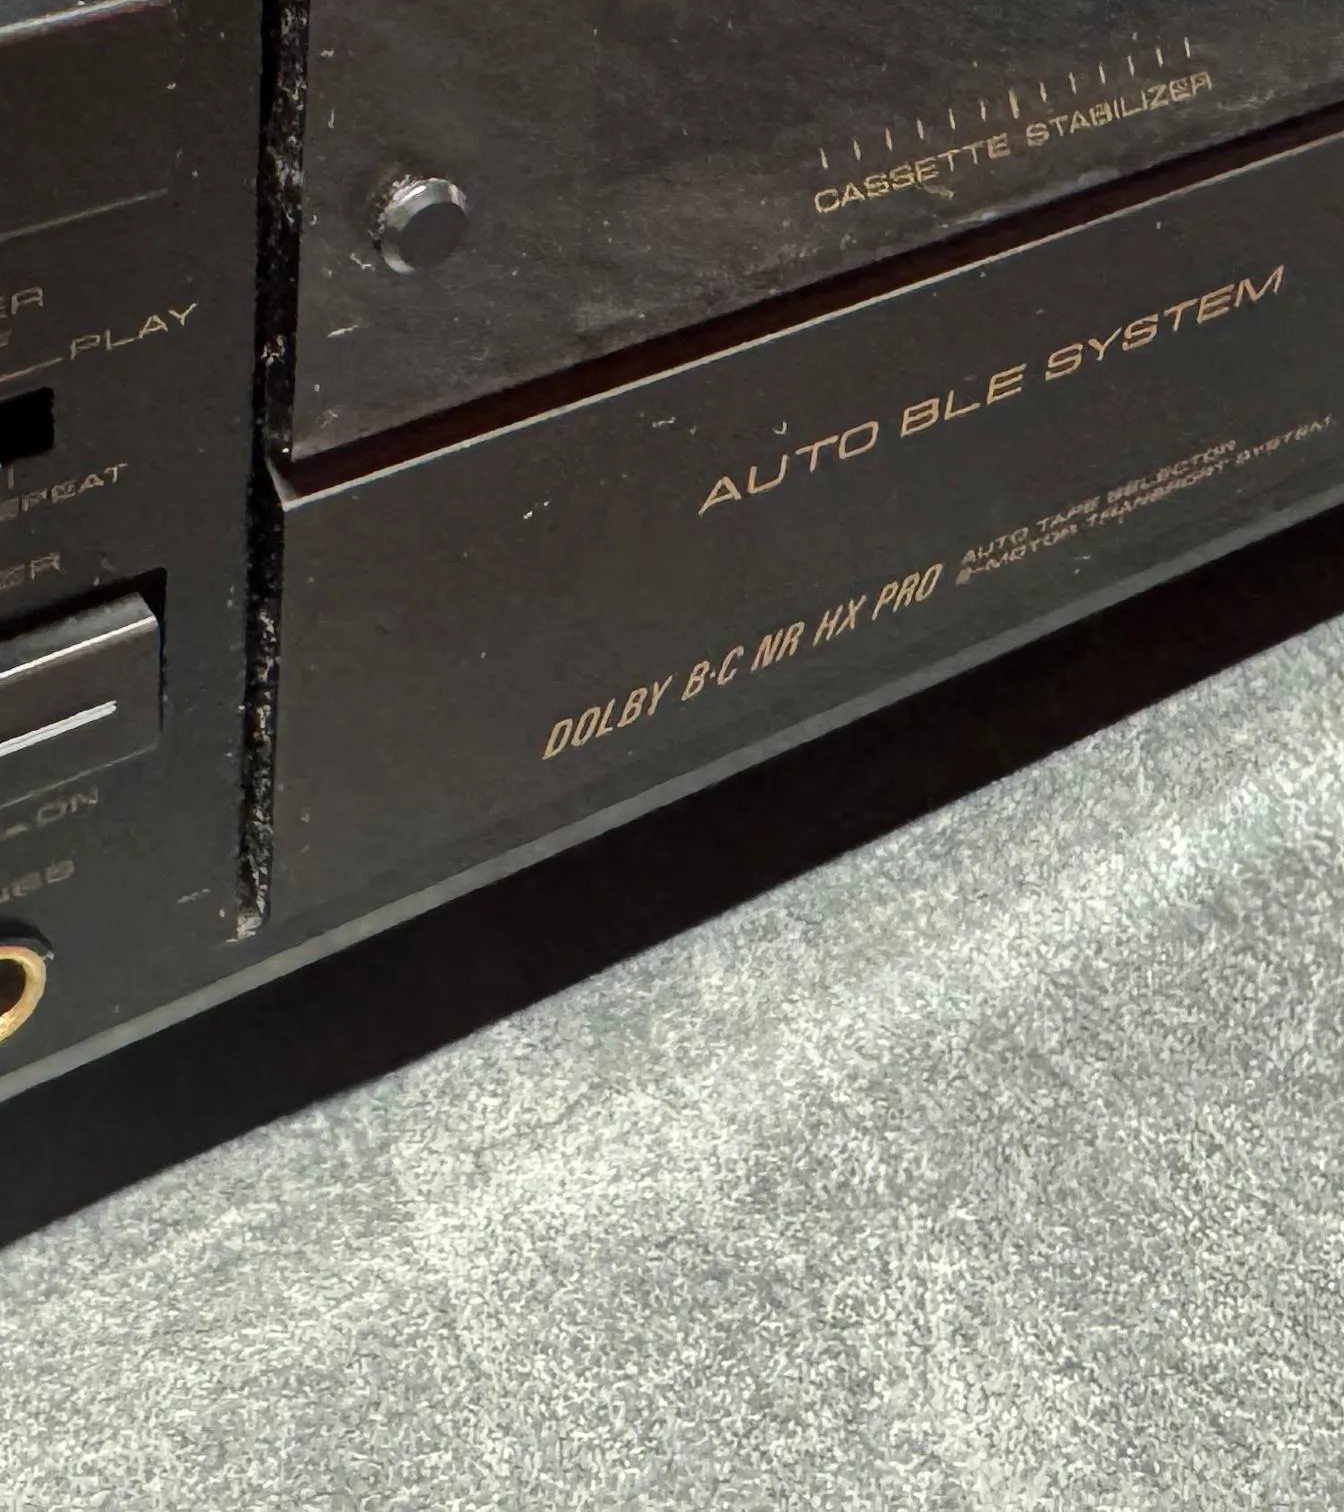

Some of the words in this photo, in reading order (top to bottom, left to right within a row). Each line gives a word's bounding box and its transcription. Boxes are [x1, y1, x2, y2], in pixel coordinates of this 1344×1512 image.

[814, 132, 1010, 213] CASSETTE
[1025, 72, 1212, 147] STABILIZER
[70, 303, 198, 360] PLAY
[698, 420, 879, 516] AUTO
[899, 363, 1028, 438] BLE
[1045, 264, 1285, 382] SYSTEM
[961, 527, 1030, 565] AUTO
[1036, 495, 1101, 533] TAPE
[542, 675, 673, 760] DOLBY
[751, 620, 805, 672] NR
[813, 594, 867, 646] HX
[872, 563, 943, 620] PRO
